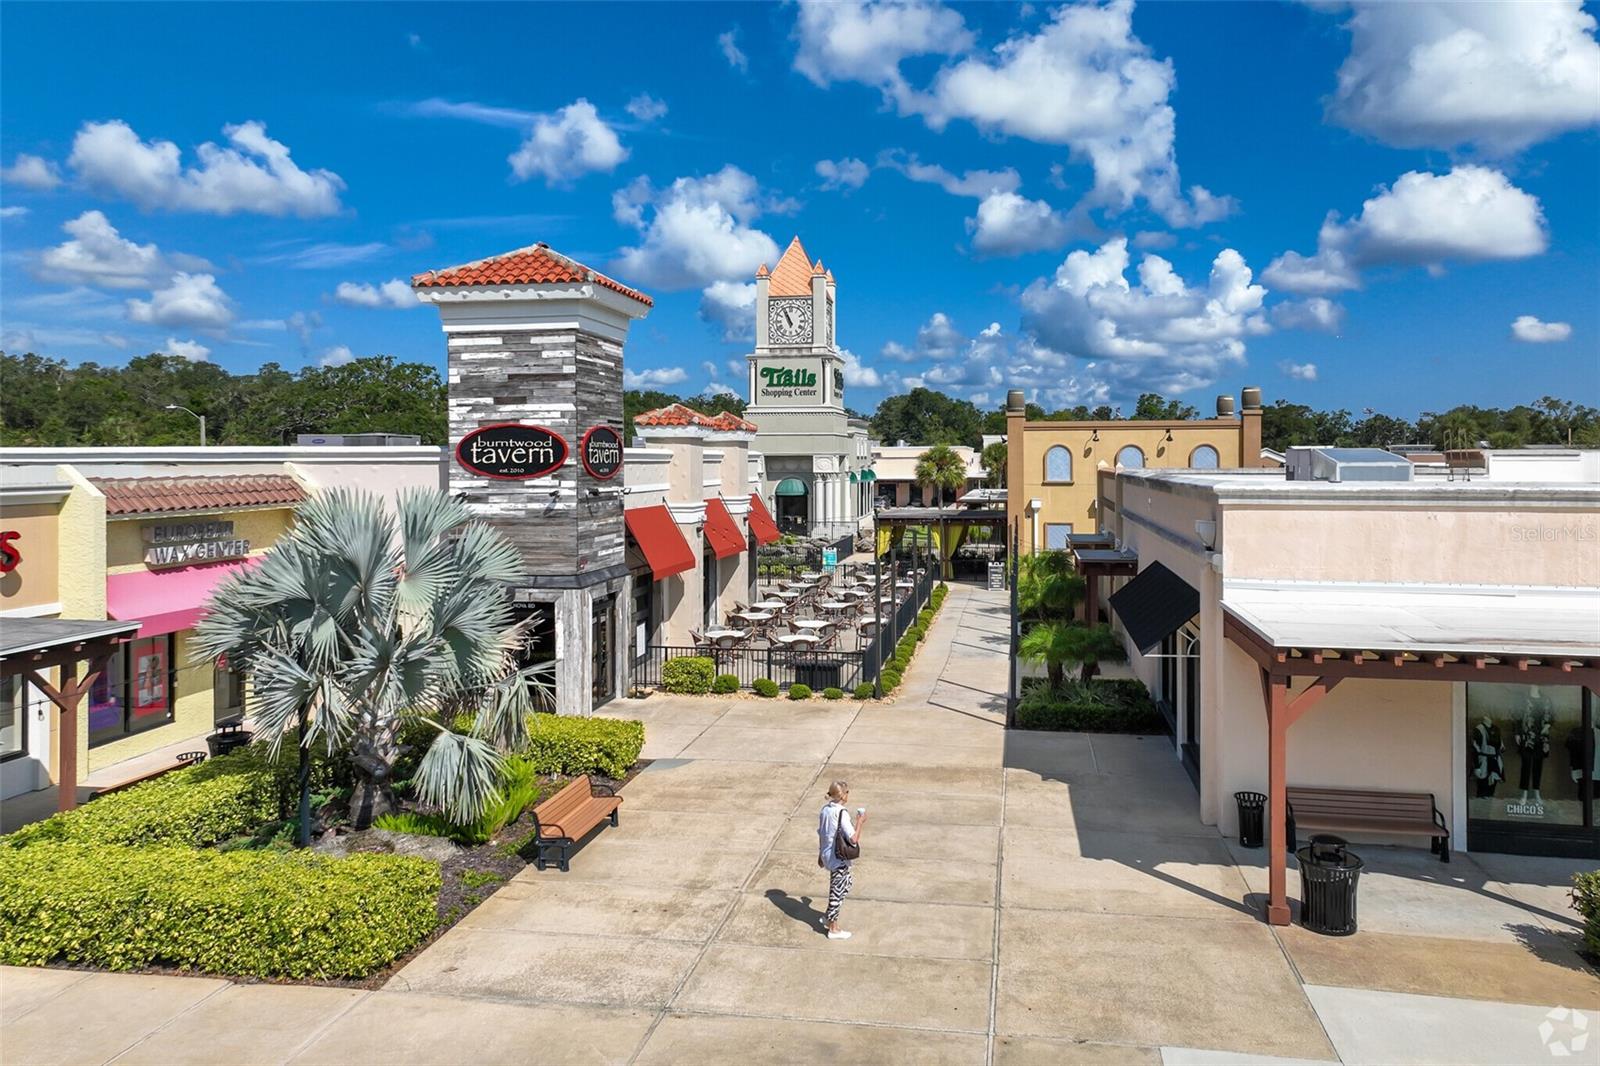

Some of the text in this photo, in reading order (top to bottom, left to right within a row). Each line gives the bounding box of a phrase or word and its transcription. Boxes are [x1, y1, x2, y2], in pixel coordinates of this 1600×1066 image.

[760, 366, 816, 387] Trails
[761, 388, 817, 397] Shopping Center
[478, 436, 552, 447] burntwood
[470, 442, 553, 464] tavern
[588, 443, 619, 464] tavern
[154, 521, 234, 541] EUROPEAN
[155, 540, 250, 563] WAX CENTER
[1507, 803, 1544, 815] CHICO'S
